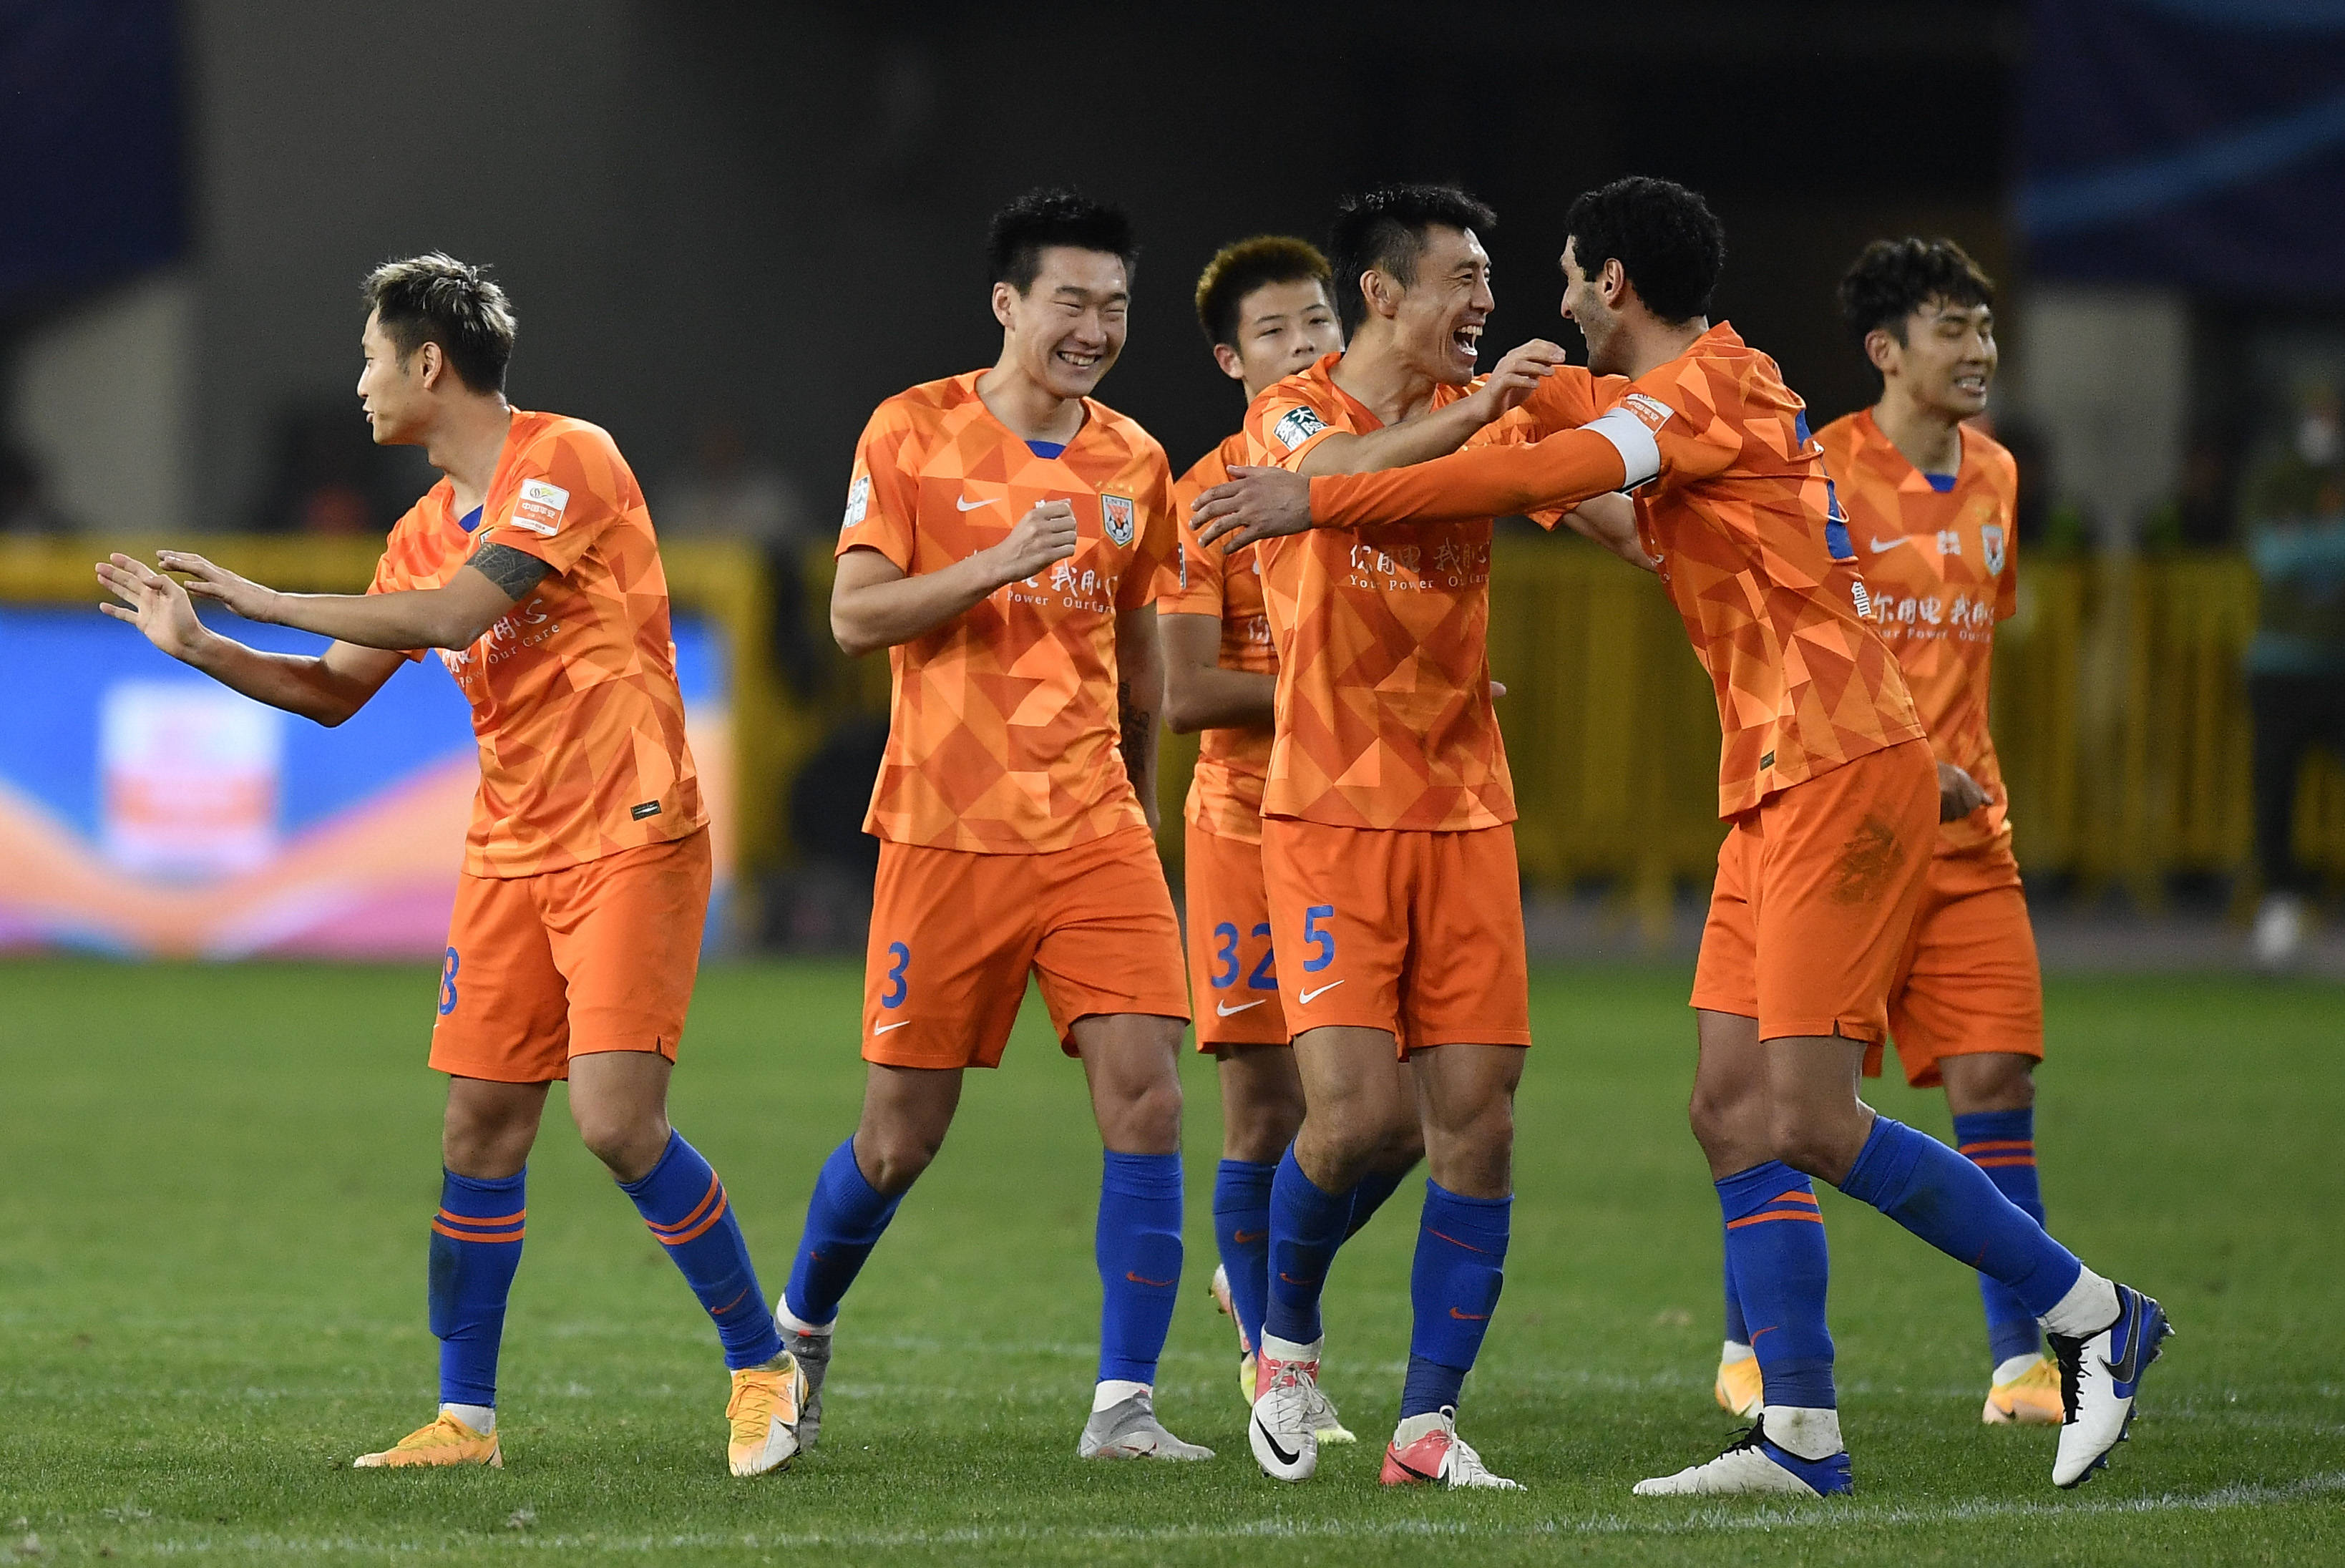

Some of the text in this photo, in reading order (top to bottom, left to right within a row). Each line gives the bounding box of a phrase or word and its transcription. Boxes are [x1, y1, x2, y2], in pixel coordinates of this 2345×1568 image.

[1007, 590, 1049, 606] Power
[1389, 580, 1434, 591] Power
[488, 646, 517, 664] Our
[522, 624, 560, 648] Care
[1211, 922, 1279, 990] 32
[1304, 905, 1335, 973] 5
[882, 941, 910, 1008] 3
